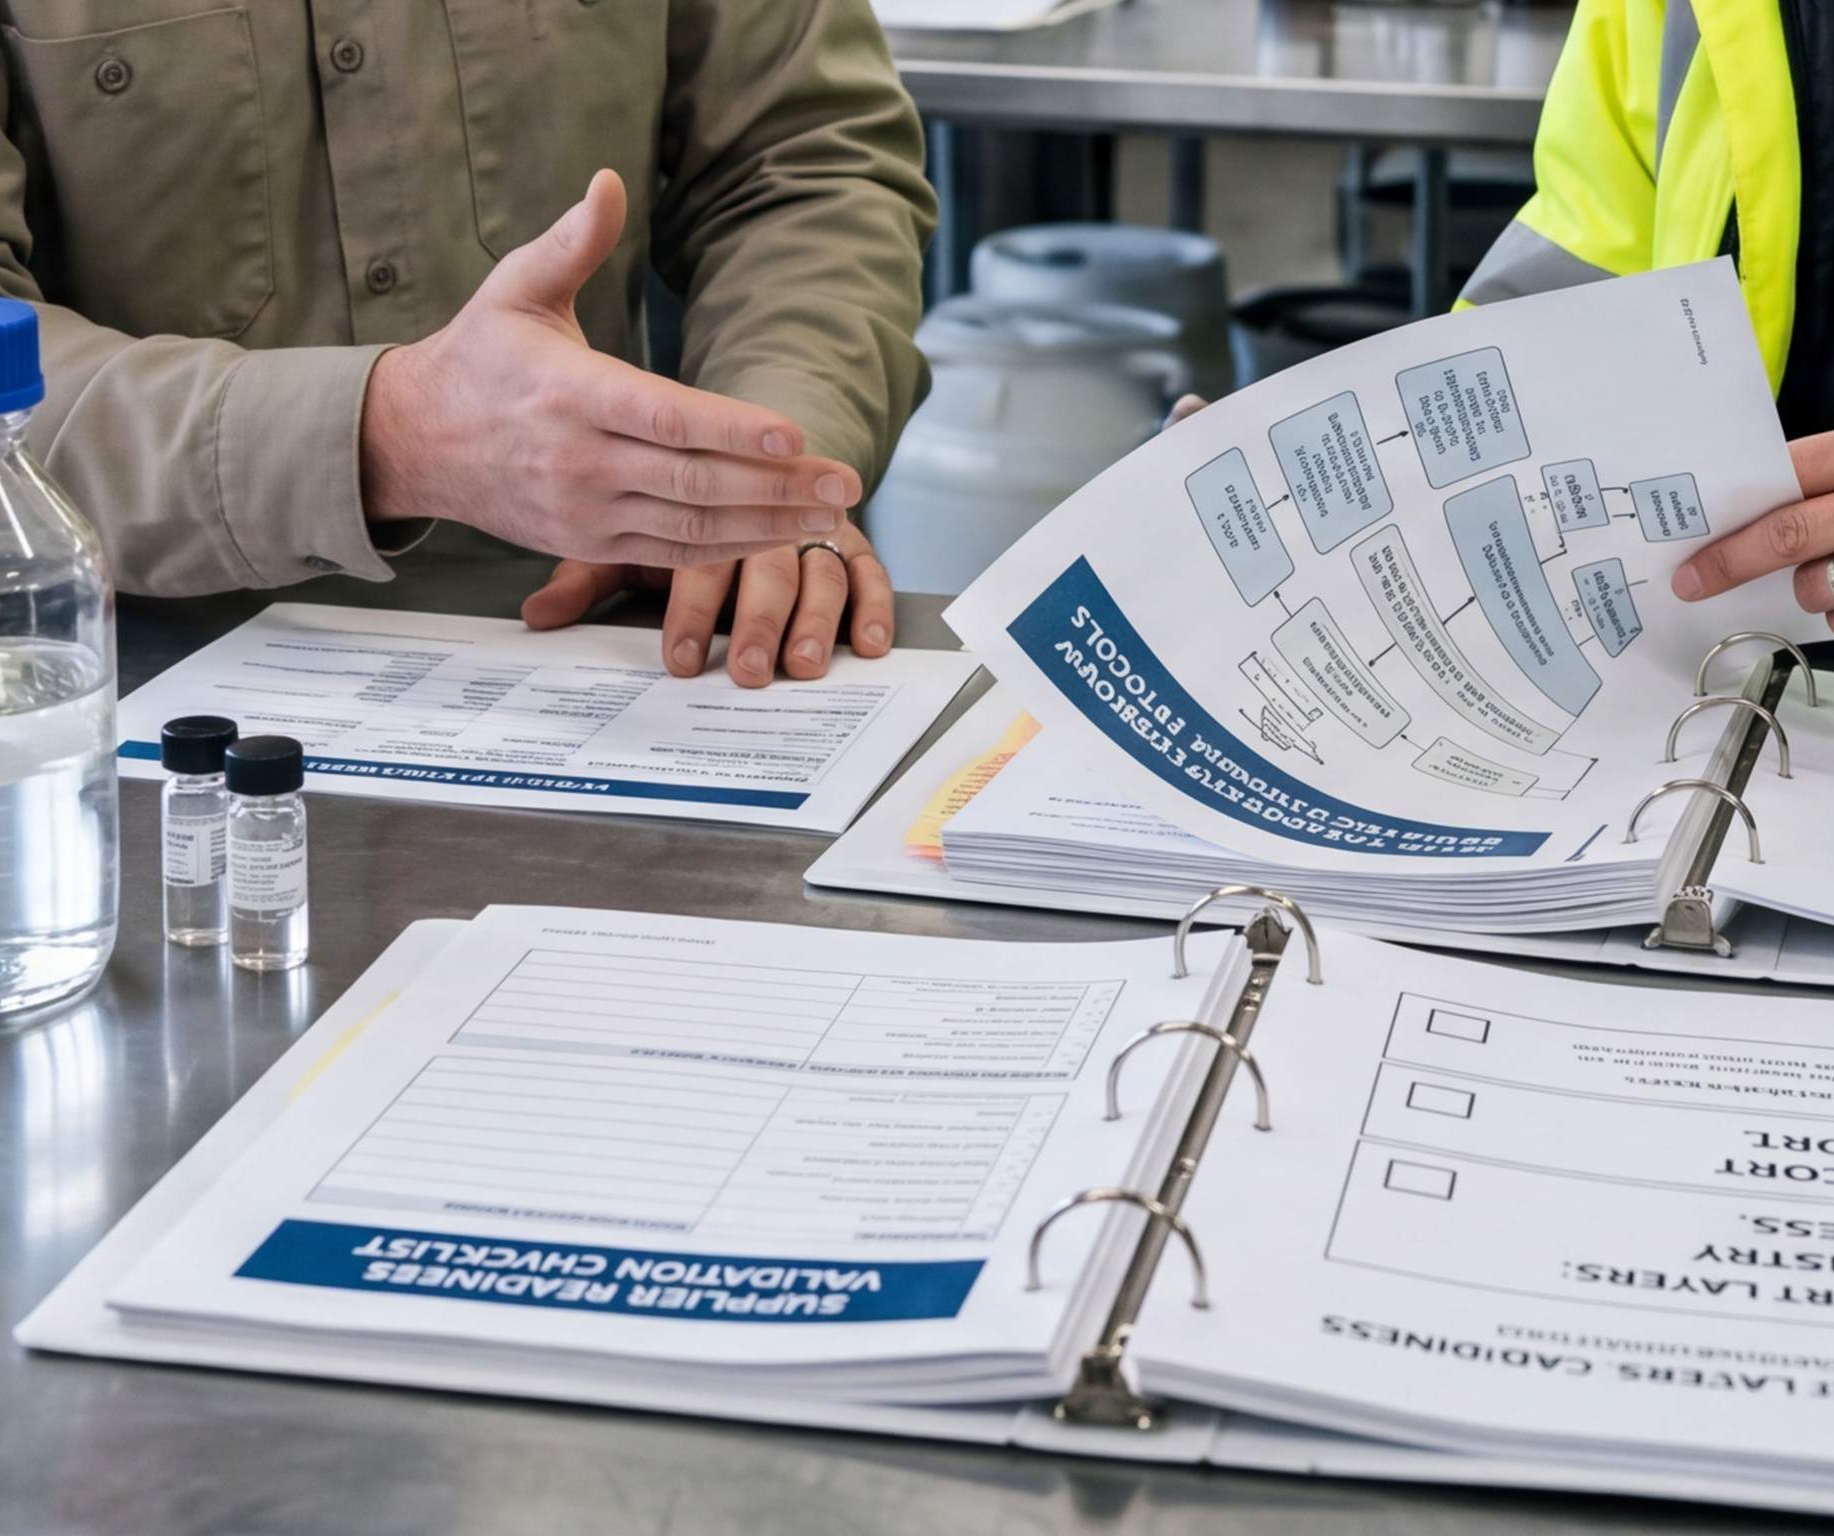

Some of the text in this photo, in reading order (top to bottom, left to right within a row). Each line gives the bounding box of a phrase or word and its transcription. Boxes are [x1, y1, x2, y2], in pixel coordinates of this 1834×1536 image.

[613, 1257, 883, 1292] VALIDATION
[1559, 1260, 1760, 1301] LAYERS:
[626, 1281, 851, 1316] SUPPLIER
